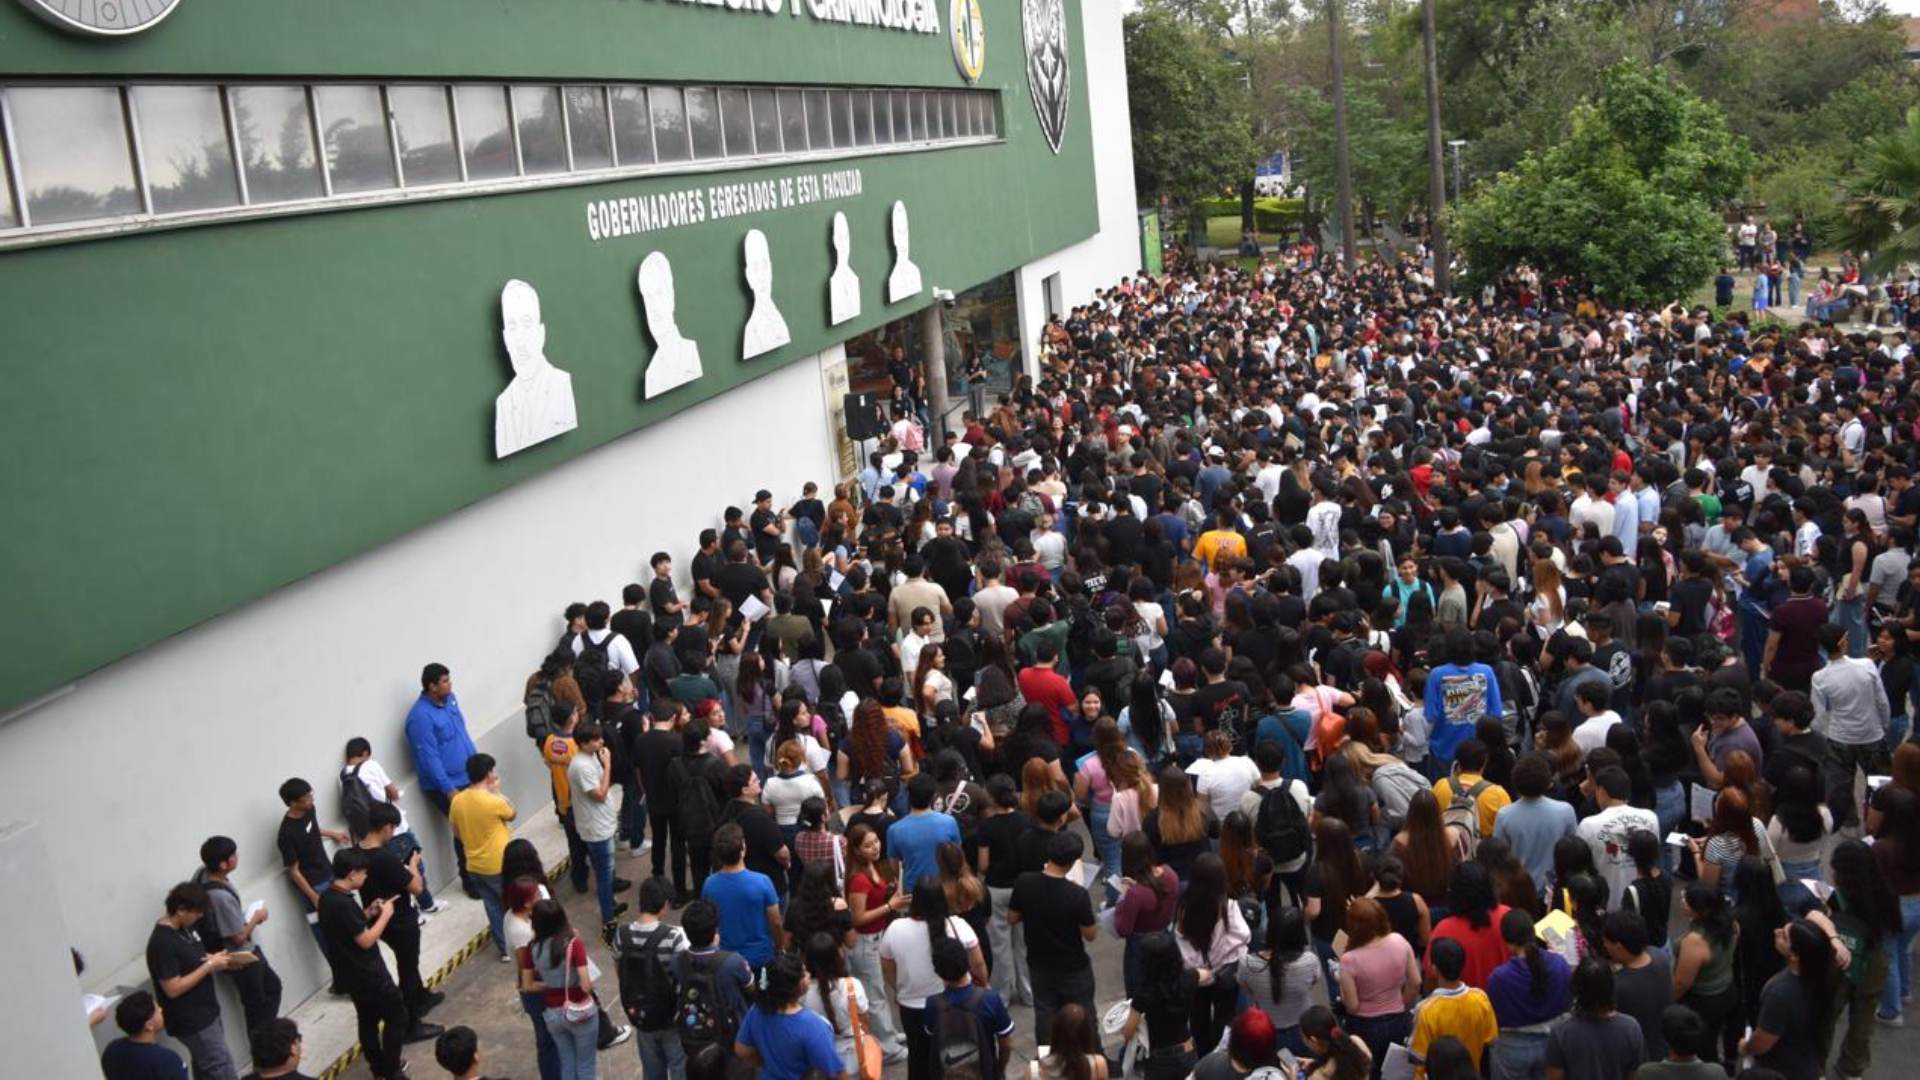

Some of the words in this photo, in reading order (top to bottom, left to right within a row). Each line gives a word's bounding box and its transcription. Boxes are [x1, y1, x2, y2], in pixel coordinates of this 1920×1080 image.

[587, 190, 705, 240] GOBERNADORES
[709, 180, 777, 218] EGRESADOS
[780, 178, 795, 207] DE
[796, 174, 821, 205] ESTA
[822, 169, 862, 199] FACULTAD
